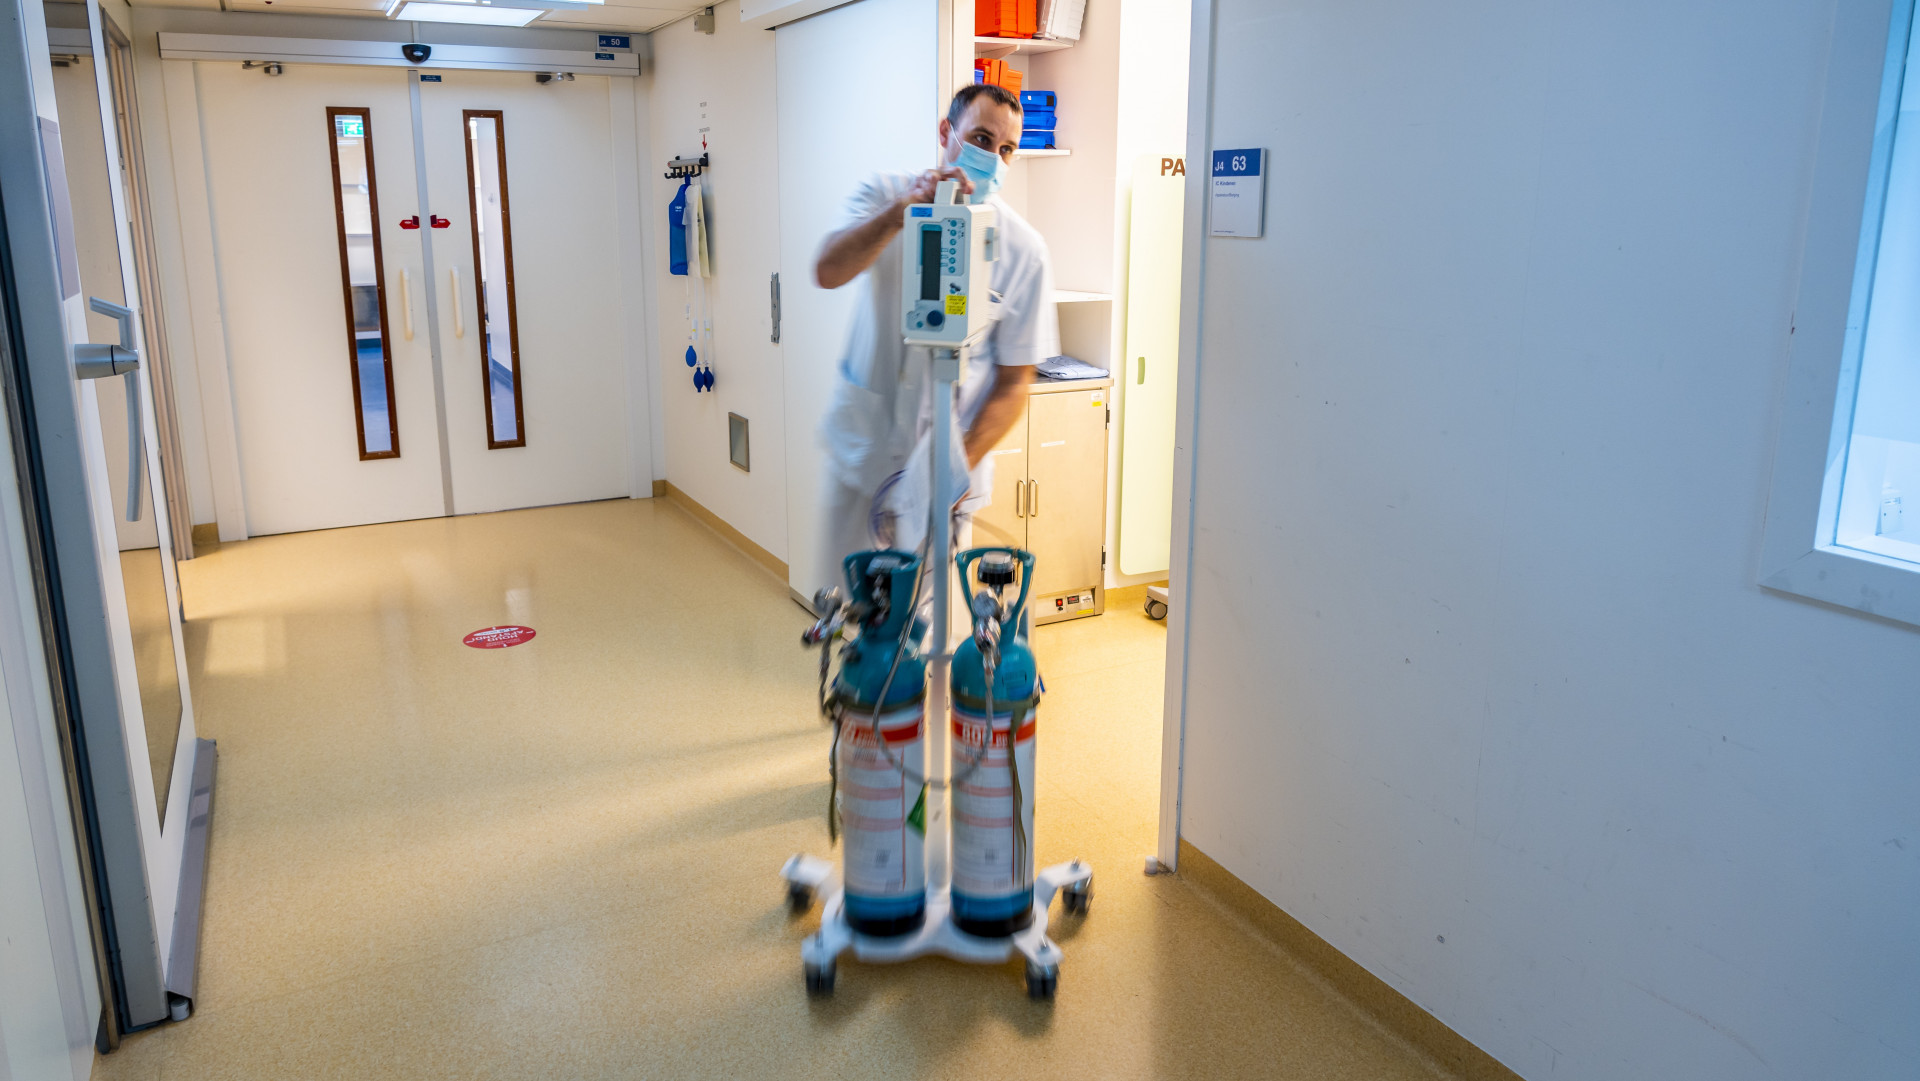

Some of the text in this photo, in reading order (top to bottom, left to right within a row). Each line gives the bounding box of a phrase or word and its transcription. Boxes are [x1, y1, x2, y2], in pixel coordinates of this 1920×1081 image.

[611, 38, 620, 46] 50
[1161, 158, 1186, 176] PA
[1215, 155, 1246, 171] J4 63
